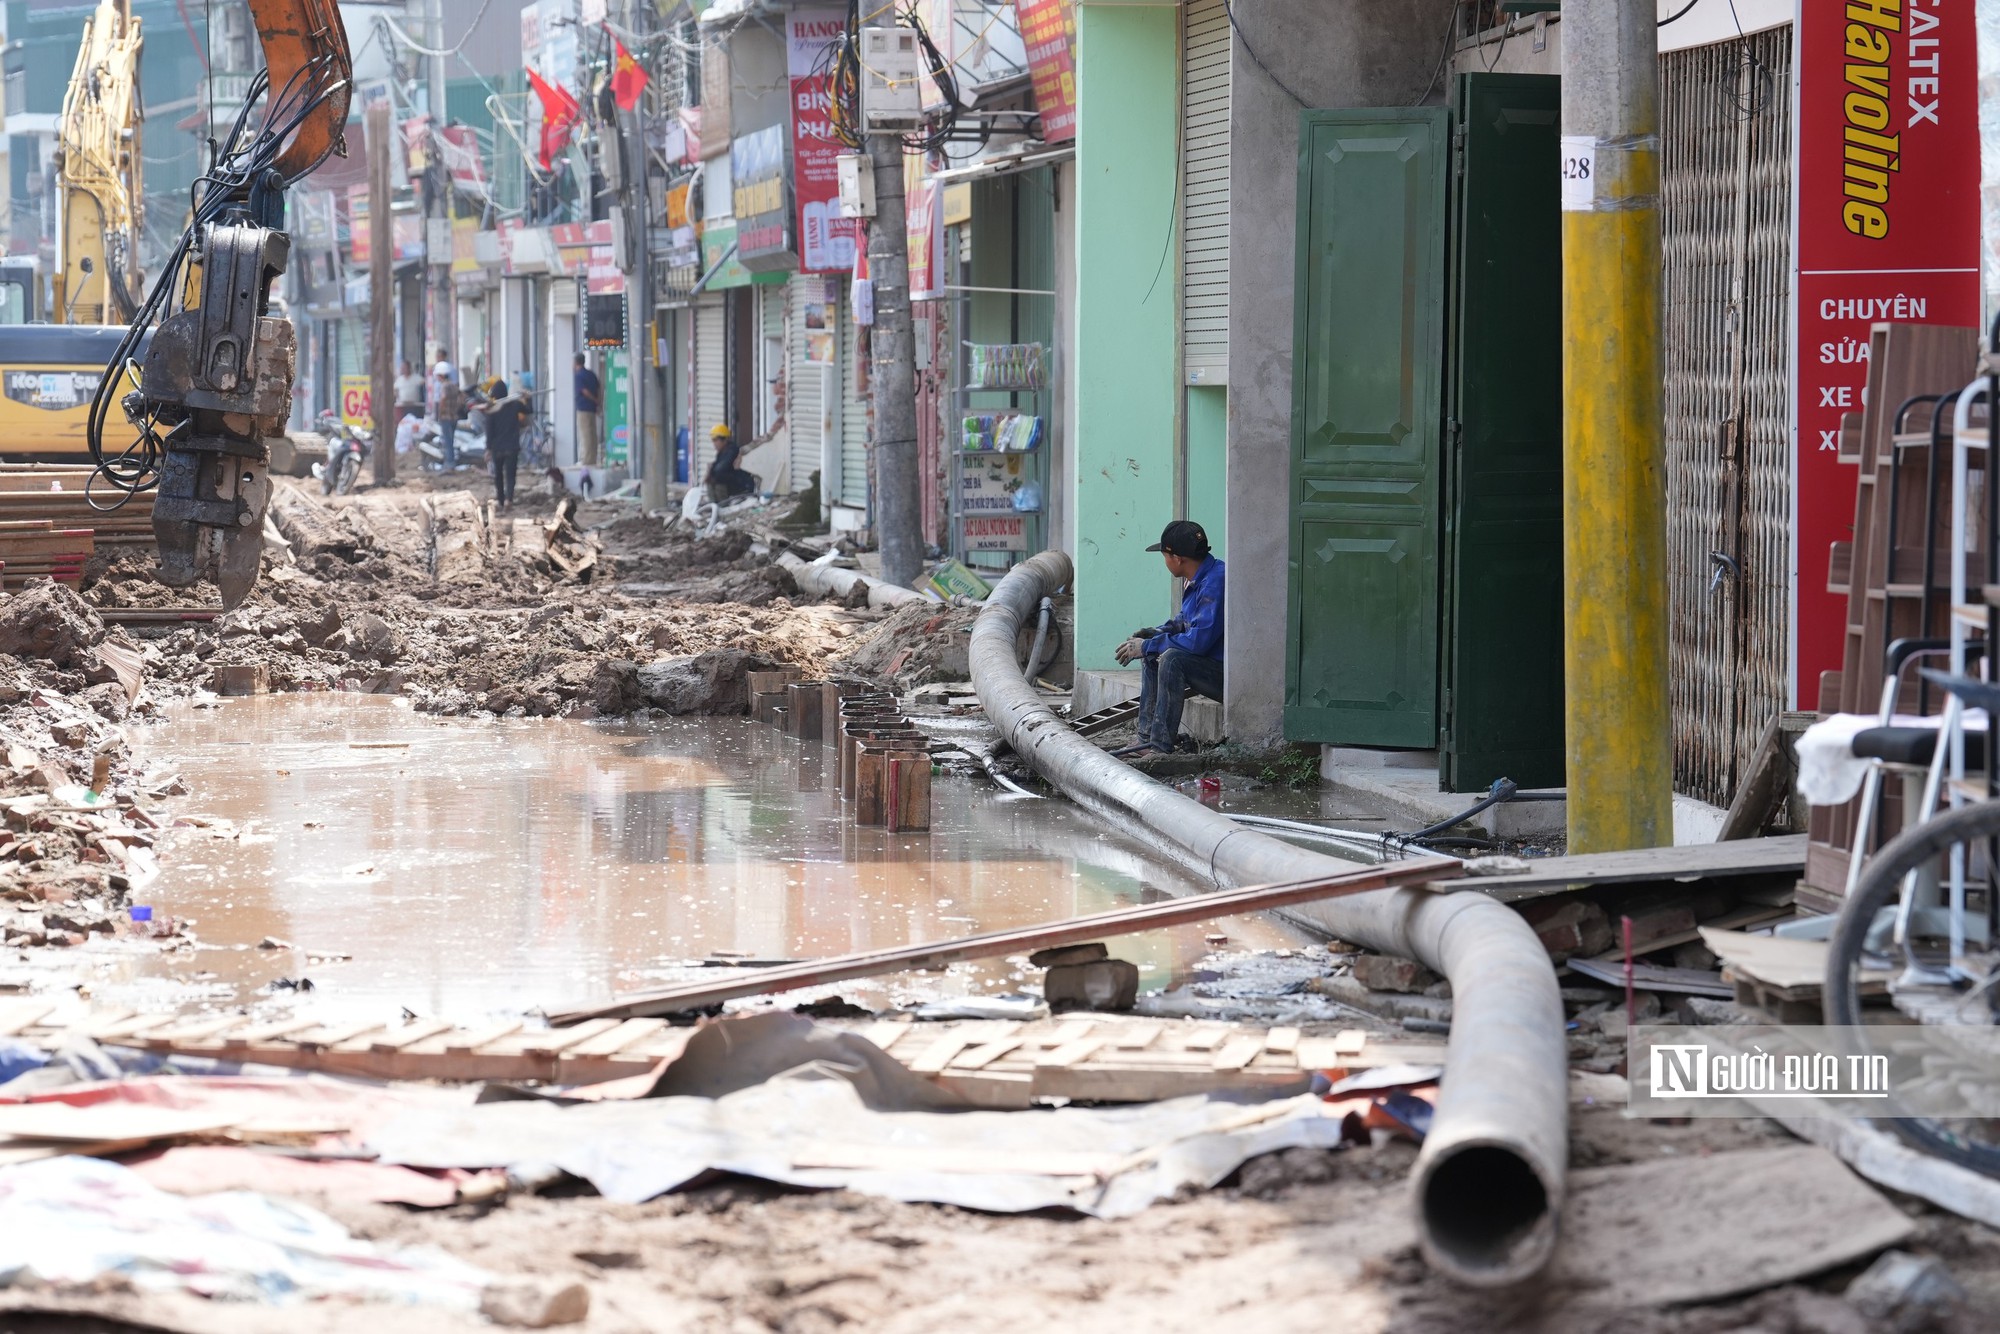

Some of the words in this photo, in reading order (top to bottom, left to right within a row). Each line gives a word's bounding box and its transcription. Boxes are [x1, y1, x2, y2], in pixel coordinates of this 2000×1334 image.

[794, 20, 845, 38] HANOI
[1908, 0, 1940, 128] ALTEX
[1820, 293, 1927, 321] CHUYÊN
[1819, 336, 1872, 364] SỬA
[1818, 386, 1852, 408] XE
[1818, 430, 1843, 451] X
